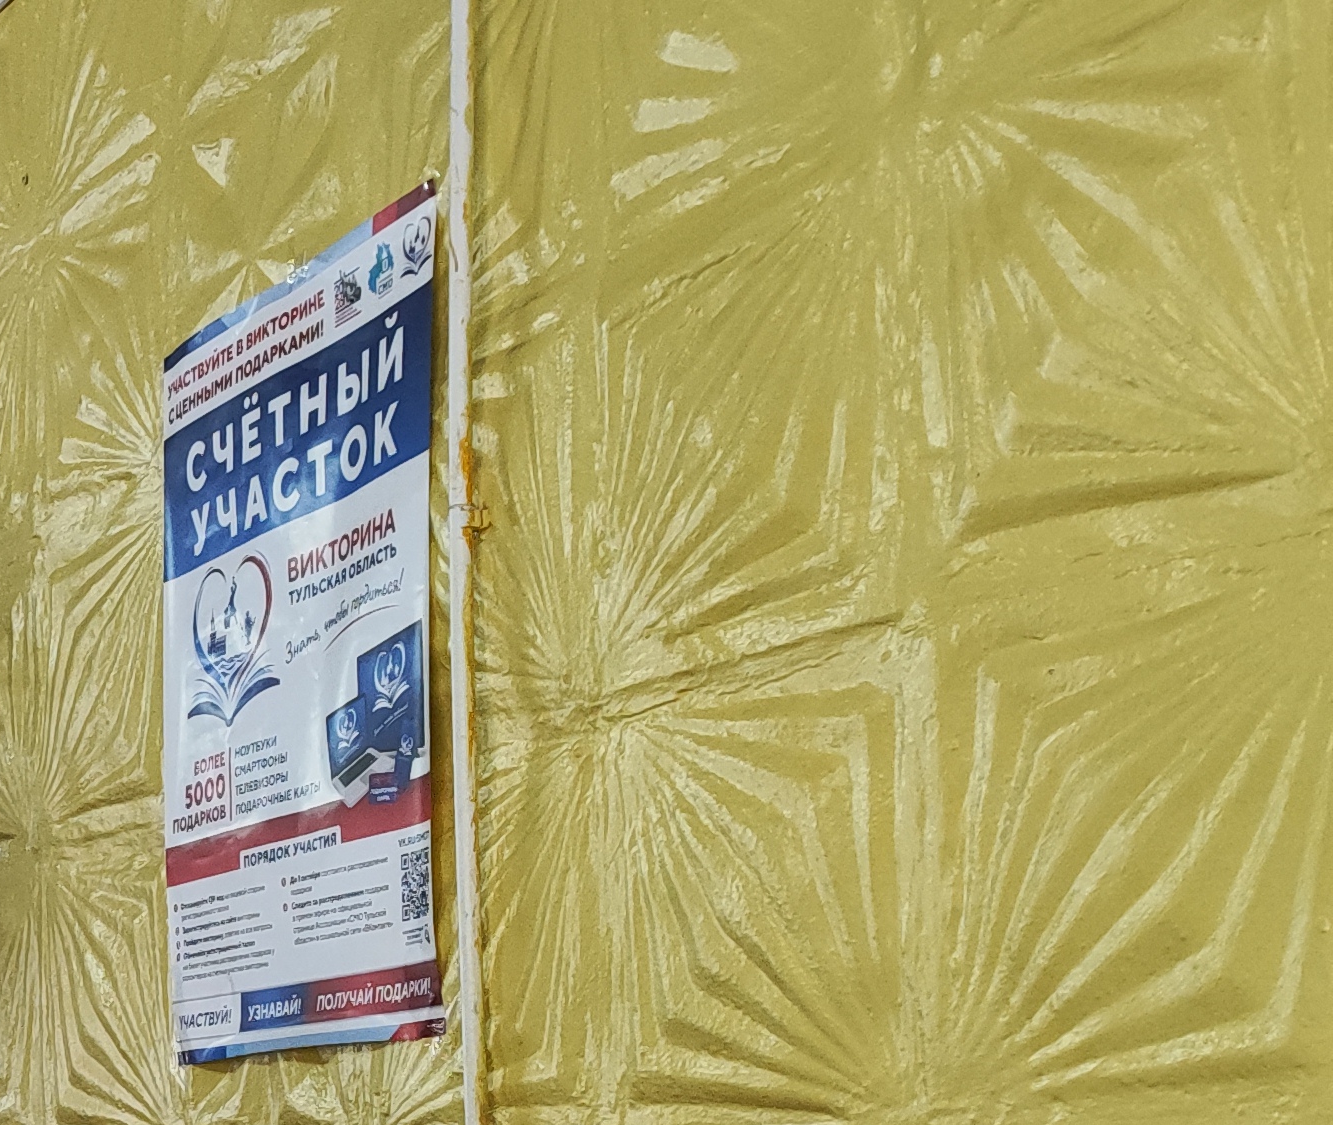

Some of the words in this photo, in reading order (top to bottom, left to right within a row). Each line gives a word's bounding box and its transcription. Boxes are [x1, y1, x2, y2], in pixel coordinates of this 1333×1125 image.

[168, 344, 234, 401] УЧАСТВУЙТЕ
[236, 338, 244, 356] В
[246, 288, 326, 350] ВИКТОРИНЕ
[235, 318, 325, 384] ПОДАРКАМИ!
[186, 310, 404, 492] СЧЁТНЫЙ
[191, 400, 399, 557] УЧАСТОК
[288, 508, 396, 583] ВИКТОРИНА
[288, 567, 347, 606] ТУЛЬСКАЯ
[349, 543, 397, 579] ОБЛАСТЬ
[285, 629, 321, 664] Знать,
[194, 751, 226, 776] БОЛЕЕ
[234, 751, 288, 778] СМАРТФОНЫ
[235, 735, 277, 759] НОУТБУКИ
[185, 773, 226, 809] 5000
[235, 770, 289, 796] ТЕЛЕВИЗОРЫ
[236, 789, 293, 815] ПОДАРОЧНЫЕ
[293, 781, 321, 799] КАРТЫ
[172, 804, 226, 834] ПОДАРКОВ
[243, 844, 291, 869] ПОРЯДОК
[292, 832, 337, 856] УЧАСТИЯ
[179, 1004, 232, 1031] УЧАСТВУЙ!
[247, 994, 302, 1022] УЗНАВАЙ!
[316, 983, 373, 1013] ПОЛУЧАЙ
[375, 977, 431, 1004] ПОДАРКИ!
